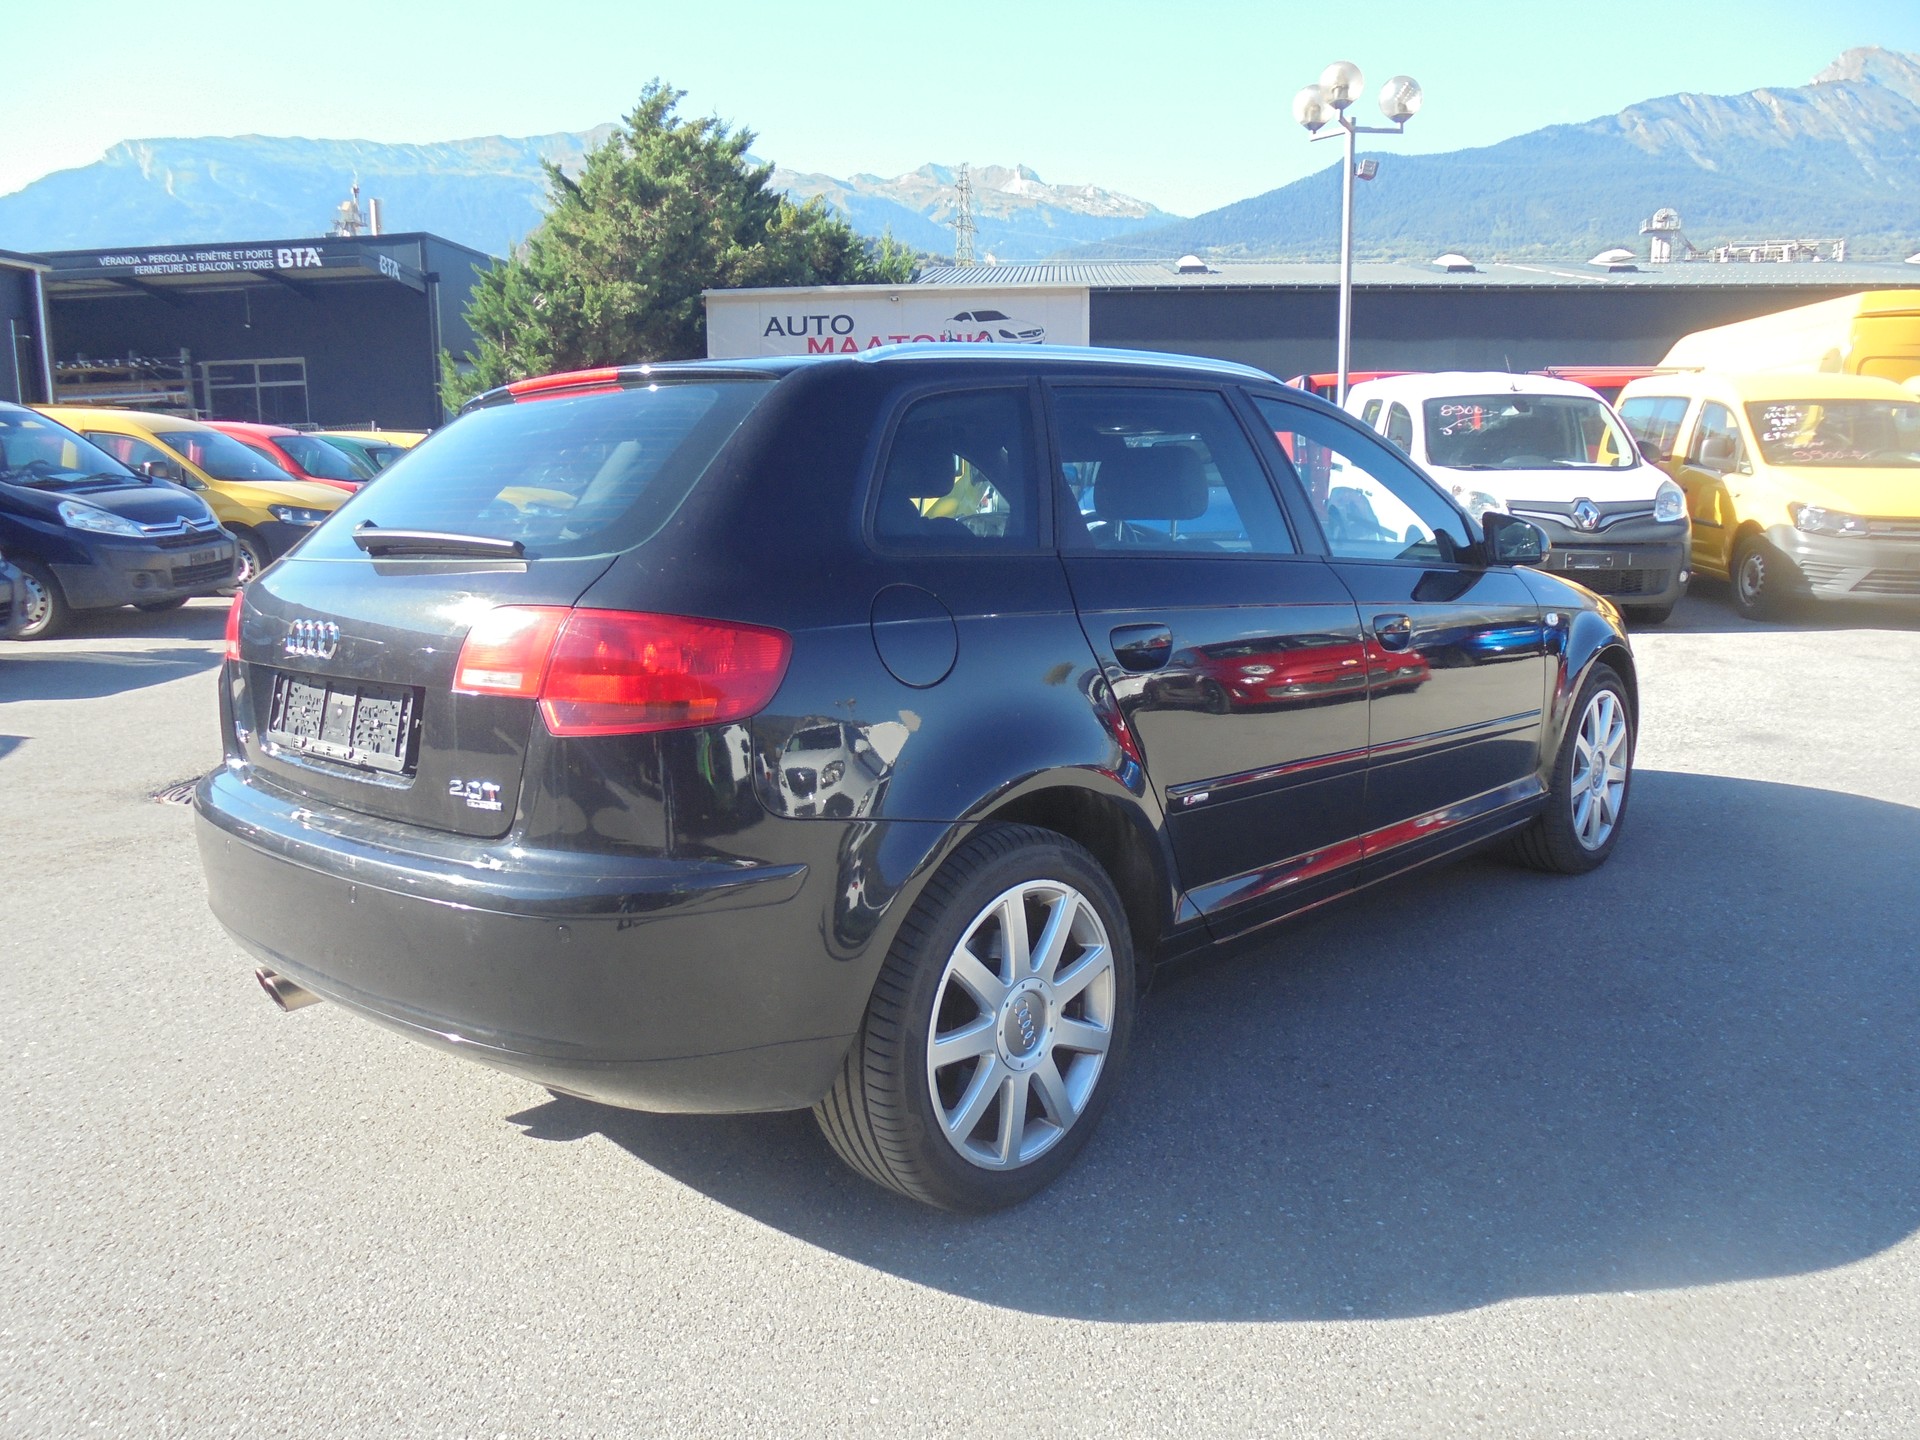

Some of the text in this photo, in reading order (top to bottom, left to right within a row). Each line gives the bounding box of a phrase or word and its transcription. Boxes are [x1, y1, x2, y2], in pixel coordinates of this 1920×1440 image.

[99, 249, 273, 266] VÉRANDA PERGOLA FENÊTRE ET PORTE
[134, 259, 274, 274] FERMETURE DE BALCON STORES
[277, 247, 322, 268] BTA
[379, 254, 400, 280] BTA
[764, 314, 855, 337] AUTO
